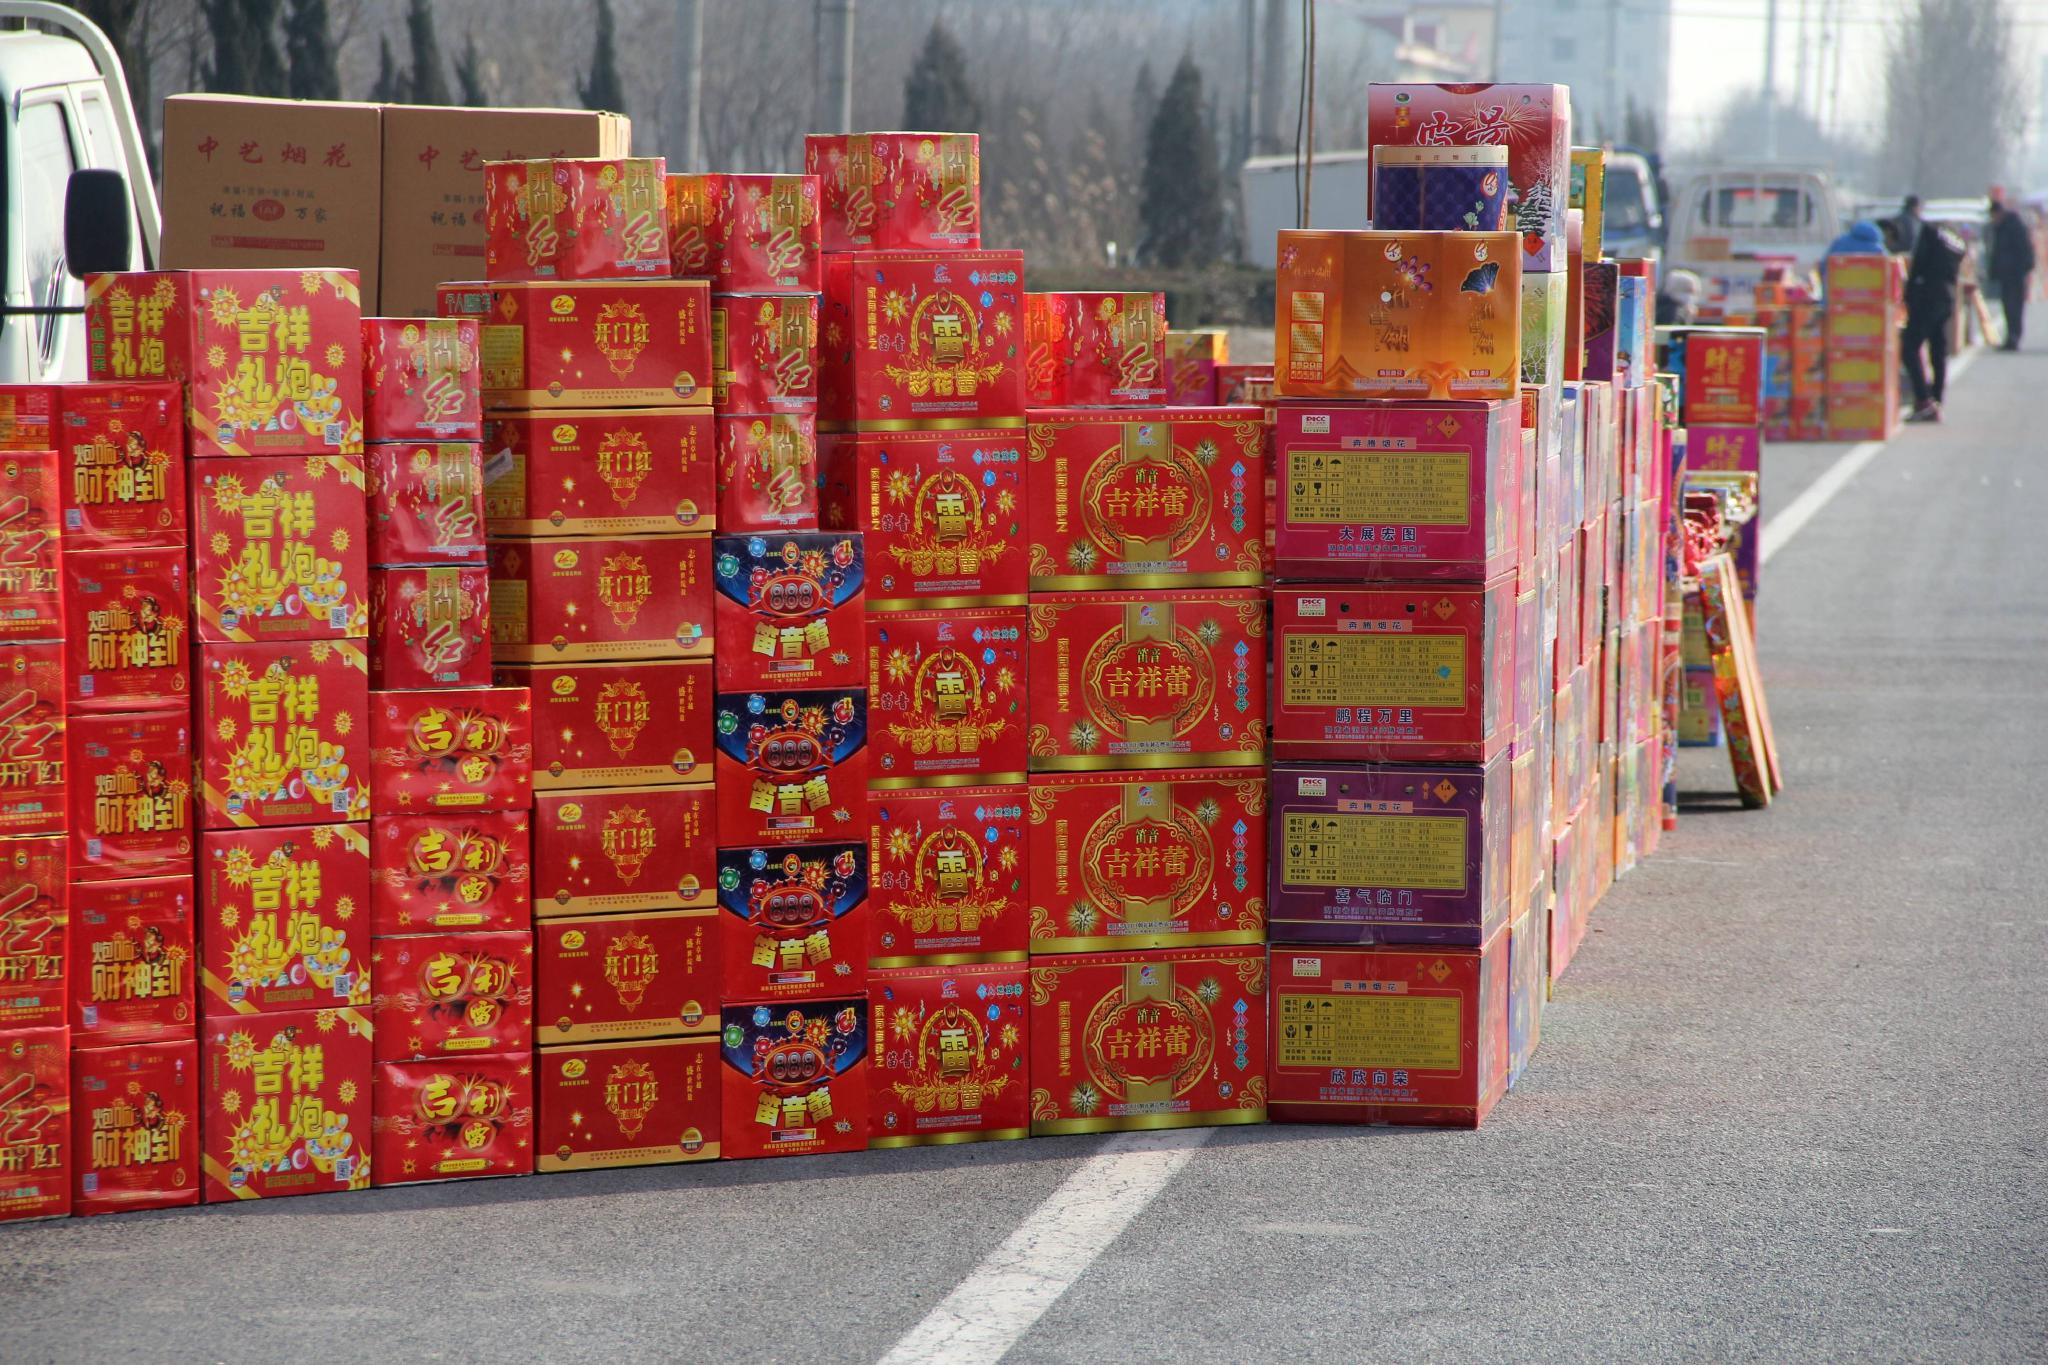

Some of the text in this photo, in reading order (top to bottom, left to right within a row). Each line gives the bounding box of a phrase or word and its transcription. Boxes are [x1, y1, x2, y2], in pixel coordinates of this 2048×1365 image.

[197, 135, 351, 168] 中艺烟花
[111, 295, 165, 335] 吉祥
[237, 305, 312, 353] 吉祥
[594, 322, 650, 344] 开门红
[111, 336, 165, 377] 礼炮
[237, 356, 312, 403] 礼炮
[1352, 439, 1406, 448] 奔腾烟花
[597, 450, 653, 472] 开门红
[1135, 468, 1158, 484] 笛音
[74, 464, 166, 504] 财神到
[240, 491, 317, 538] 吉祥
[1105, 486, 1189, 517] 吉祥蕾
[1339, 525, 1417, 542] 大展宏图
[240, 541, 317, 588] 礼炮
[598, 575, 653, 597] 开门红
[770, 583, 813, 610] 888
[1348, 621, 1402, 630] 奔腾烟花
[87, 630, 178, 670] 财神到
[1137, 648, 1161, 664] 笛音
[1106, 665, 1192, 697] 吉祥蕾
[247, 675, 320, 724] 吉祥
[595, 701, 650, 722] 开门红
[416, 707, 497, 752] 吉利
[1335, 708, 1414, 724] 鹏程万里
[247, 725, 320, 773] 礼炮
[767, 740, 812, 766] 888
[94, 795, 184, 835] 财神到
[1349, 802, 1401, 811] 奔腾烟花
[416, 828, 496, 873] 吉利
[602, 828, 657, 850] 开门红
[1136, 828, 1159, 845] 笛音
[1105, 845, 1190, 878] 吉祥蕾
[250, 860, 322, 910] 吉祥
[1335, 888, 1413, 905] 喜气临门
[770, 895, 814, 921] 888
[250, 911, 321, 960] 礼炮
[91, 961, 182, 1002] 财神到
[425, 951, 505, 997] 吉利
[604, 955, 659, 977] 开门红
[1343, 982, 1396, 991] 奔腾烟花
[1137, 1008, 1160, 1025] 笛音
[1106, 1024, 1191, 1058] 吉祥蕾
[252, 1044, 324, 1094] 吉祥
[773, 1052, 816, 1079] 888
[1330, 1068, 1409, 1086] 欣欣向荣
[422, 1073, 502, 1118] 吉利
[604, 1081, 659, 1105] 开门红
[251, 1096, 324, 1145] 礼炮
[91, 1127, 182, 1169] 财神到
